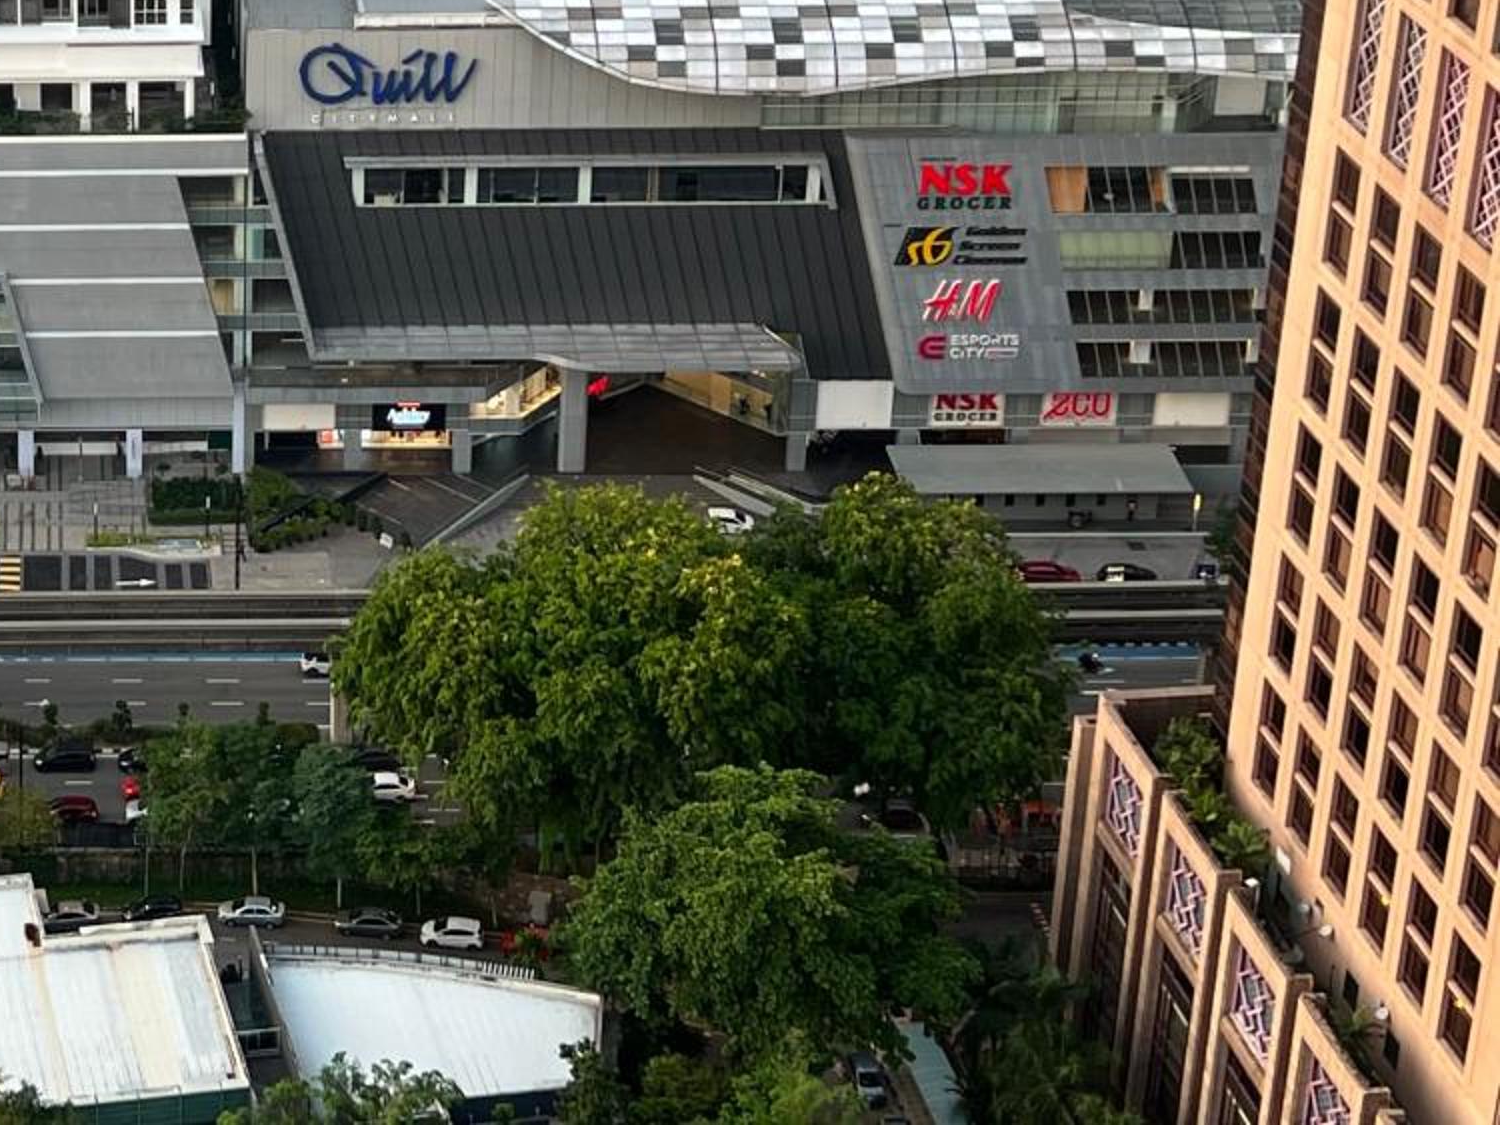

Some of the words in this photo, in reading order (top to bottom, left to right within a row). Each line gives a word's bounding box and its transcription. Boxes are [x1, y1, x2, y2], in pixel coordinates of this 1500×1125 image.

[299, 42, 477, 105] Quill
[918, 163, 1013, 195] NSK
[917, 196, 1012, 210] GROCER
[951, 334, 1020, 346] ESPORTS
[935, 394, 998, 410] NSK
[934, 413, 997, 422] GROCER
